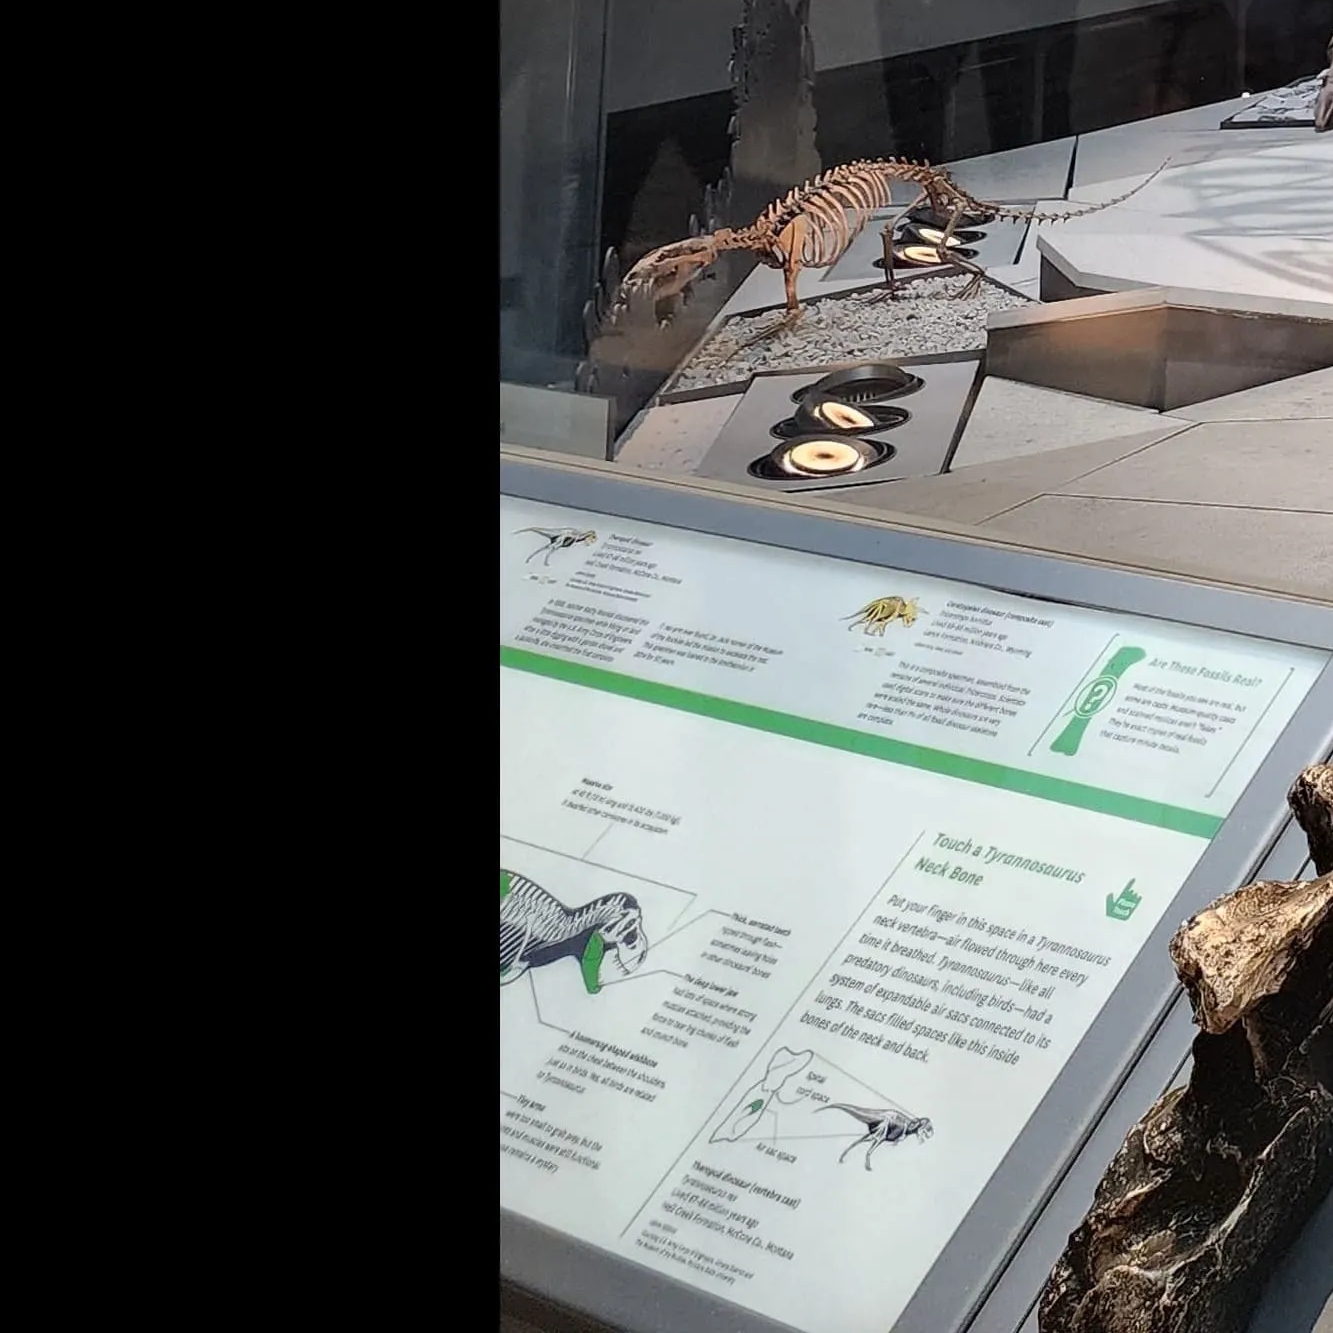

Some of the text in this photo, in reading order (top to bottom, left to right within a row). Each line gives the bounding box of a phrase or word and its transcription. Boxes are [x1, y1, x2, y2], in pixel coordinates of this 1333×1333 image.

[1148, 658, 1263, 687] Are These Fossils Real?
[914, 857, 984, 886] Neck Bone
[933, 832, 1085, 884] Touch a Tyrannosaurus
[873, 915, 898, 929] neck
[960, 937, 998, 958] flowed
[995, 949, 1036, 971] through
[1034, 958, 1060, 976] here
[1059, 968, 1089, 988] every
[887, 894, 1112, 967] Put your finger in this space in a Tyrannosaurus
[841, 954, 893, 978] predatory
[891, 967, 940, 992] dinosaurs,
[941, 980, 990, 1008] including
[1044, 1014, 1053, 1025] a
[858, 933, 883, 948] time
[881, 938, 892, 951] it
[890, 941, 937, 964] breathed.
[1038, 986, 1056, 1000] all
[800, 1011, 928, 1063] bones of the neck and back.
[814, 990, 1020, 1065] lungs. The sacs filled spaces like this inside
[829, 973, 1052, 1049] system of expandable air sacs connected to its
